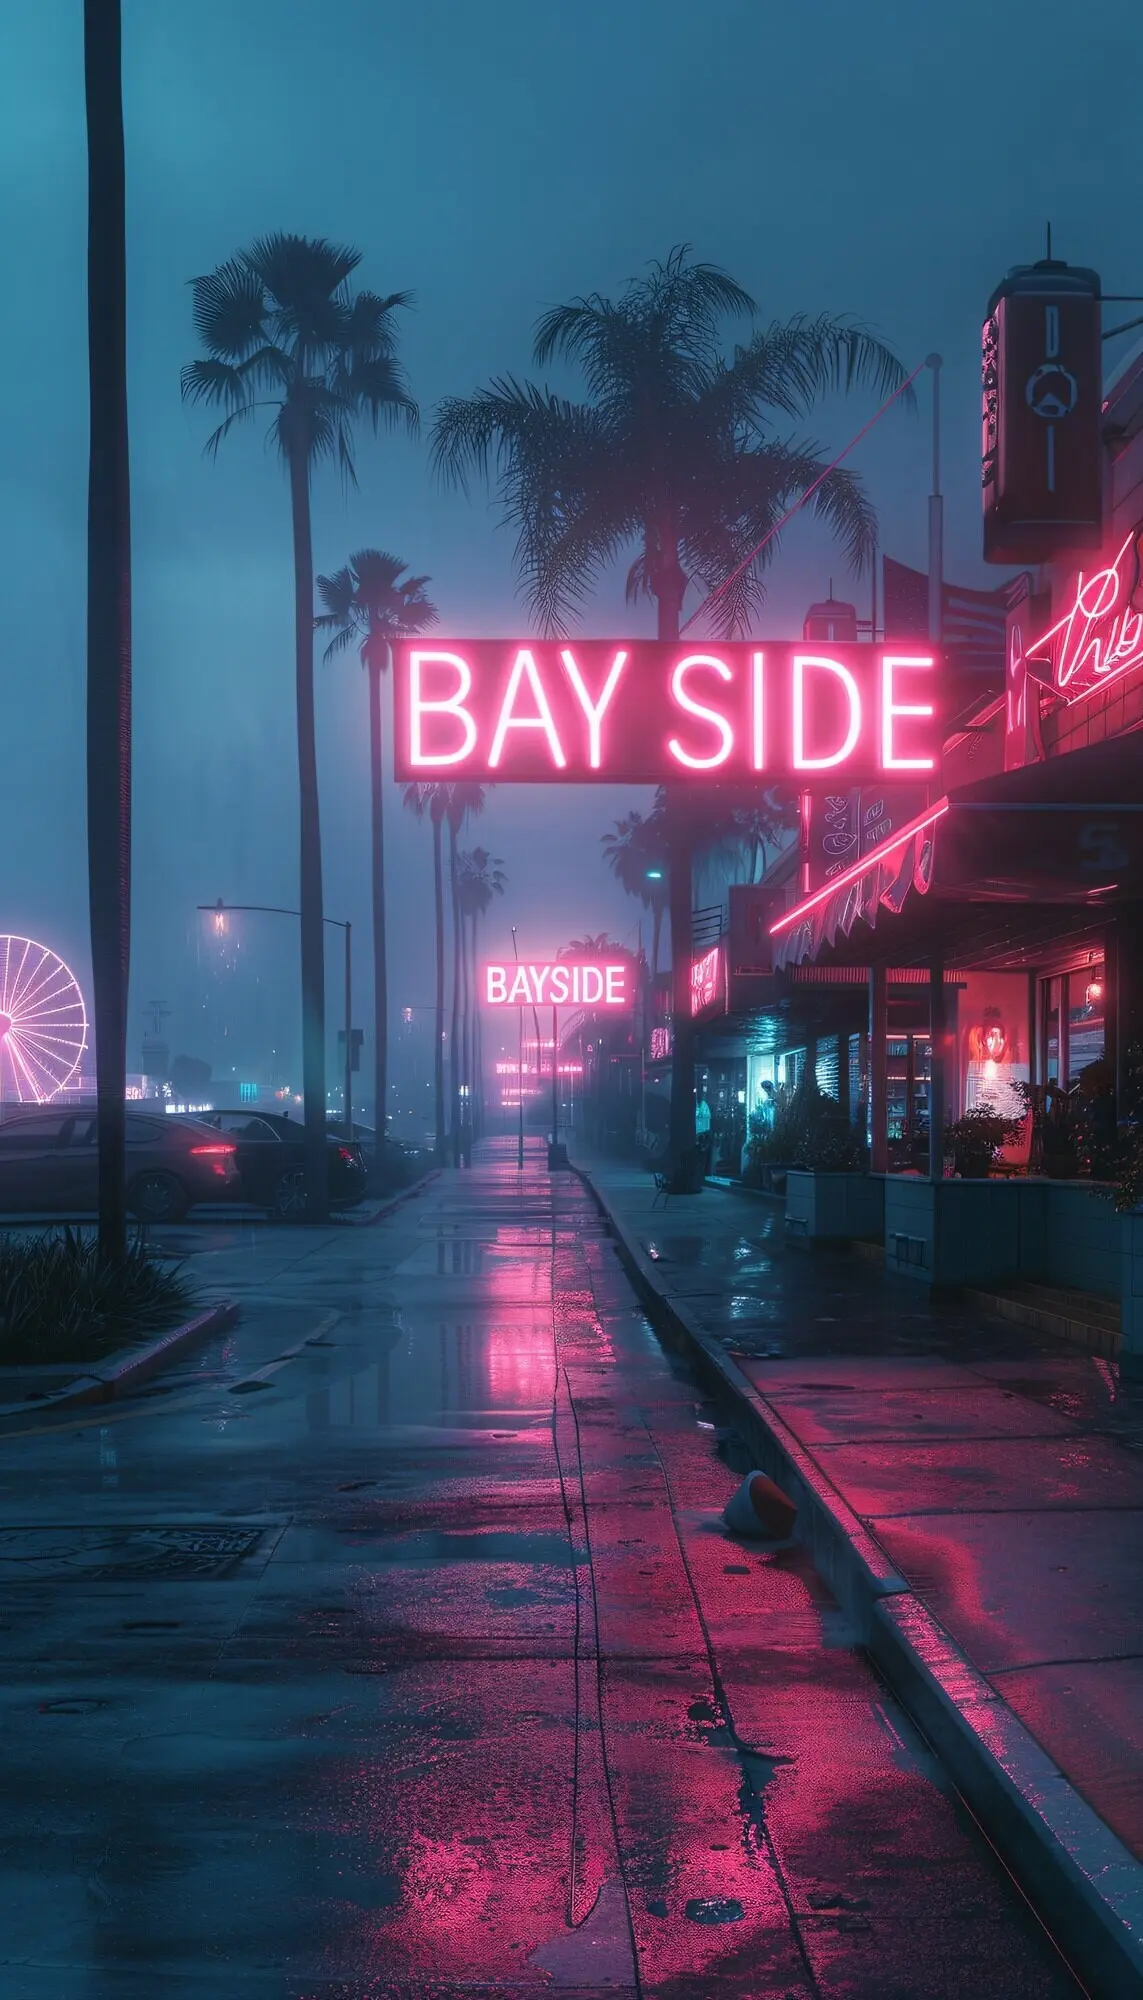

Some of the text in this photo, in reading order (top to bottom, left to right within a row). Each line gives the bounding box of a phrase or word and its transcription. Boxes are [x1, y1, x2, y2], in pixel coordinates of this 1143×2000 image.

[409, 649, 935, 769] BAY SIDE
[487, 965, 625, 1004] BAYSIDE
